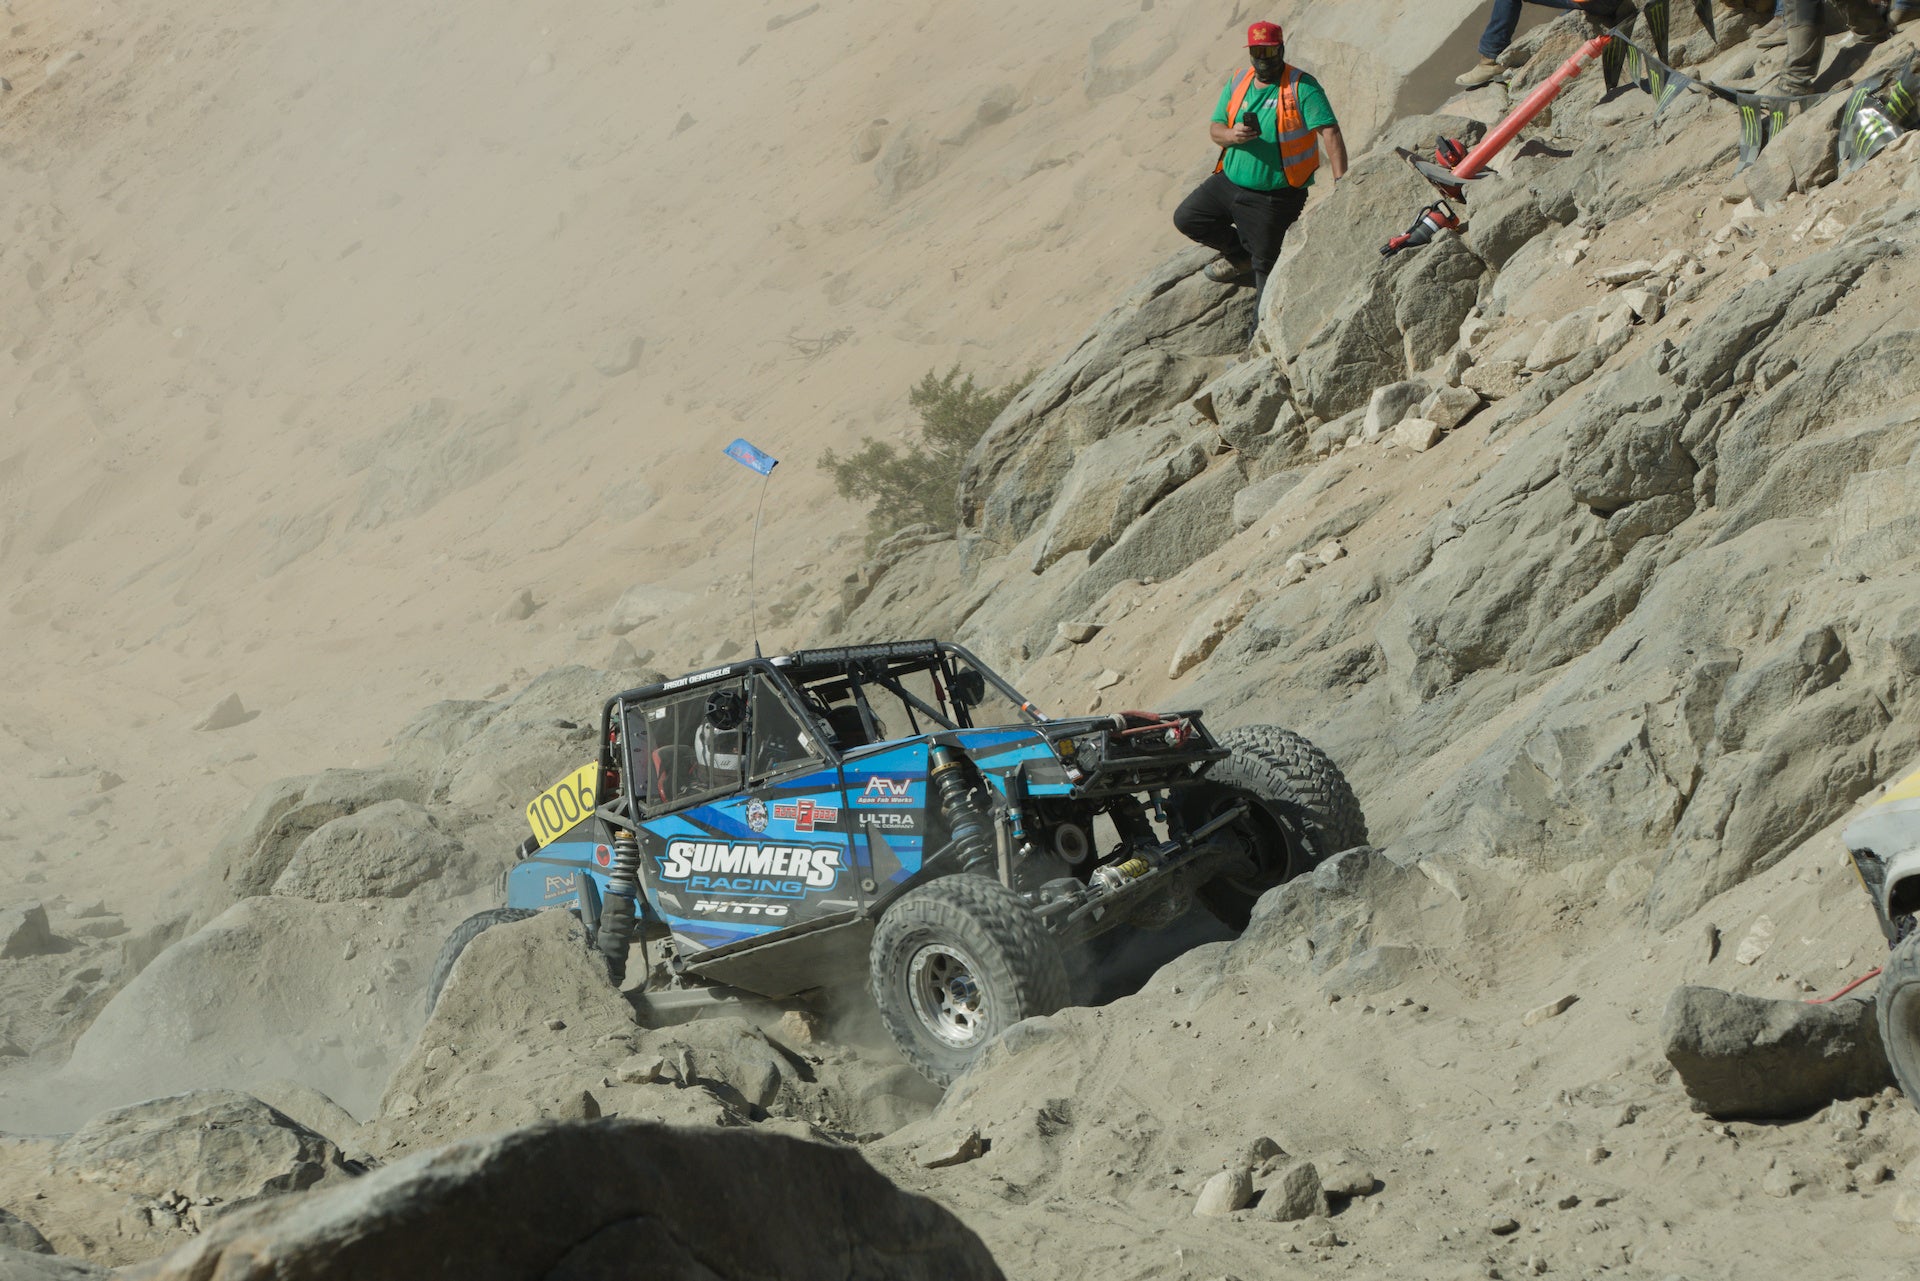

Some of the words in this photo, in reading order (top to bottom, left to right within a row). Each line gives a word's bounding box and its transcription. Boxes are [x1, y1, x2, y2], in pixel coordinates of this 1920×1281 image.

[864, 776, 911, 795] AFW
[529, 773, 595, 839] 1006
[859, 813, 915, 825] ULTRA
[663, 842, 840, 887] SUMMERS
[546, 871, 575, 892] AFW
[691, 876, 803, 893] RACING
[693, 900, 789, 916] NITTO
